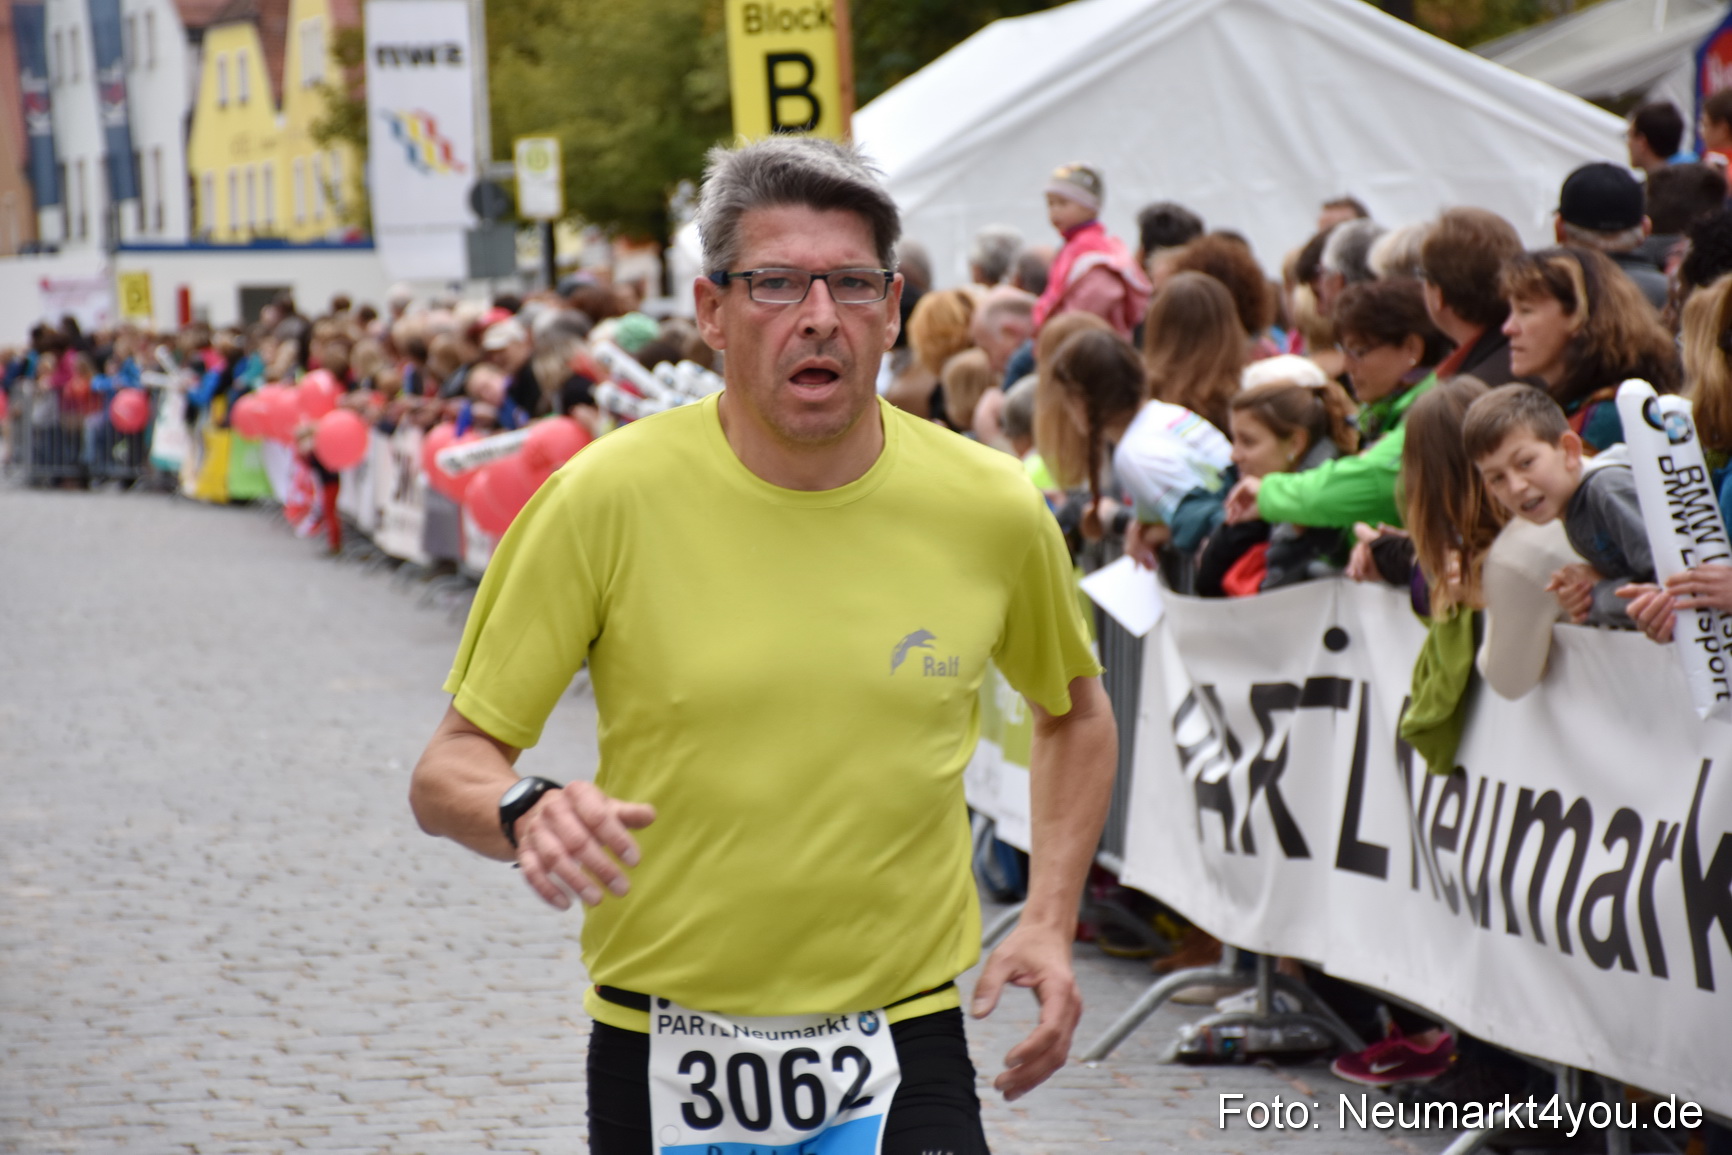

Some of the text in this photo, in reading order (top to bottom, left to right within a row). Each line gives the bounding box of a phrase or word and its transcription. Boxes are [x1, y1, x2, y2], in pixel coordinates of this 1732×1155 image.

[742, 1, 832, 35] Block
[765, 52, 822, 133] B
[1675, 464, 1726, 545] BMW
[922, 655, 960, 678] Ralf
[676, 1045, 875, 1132] 3062
